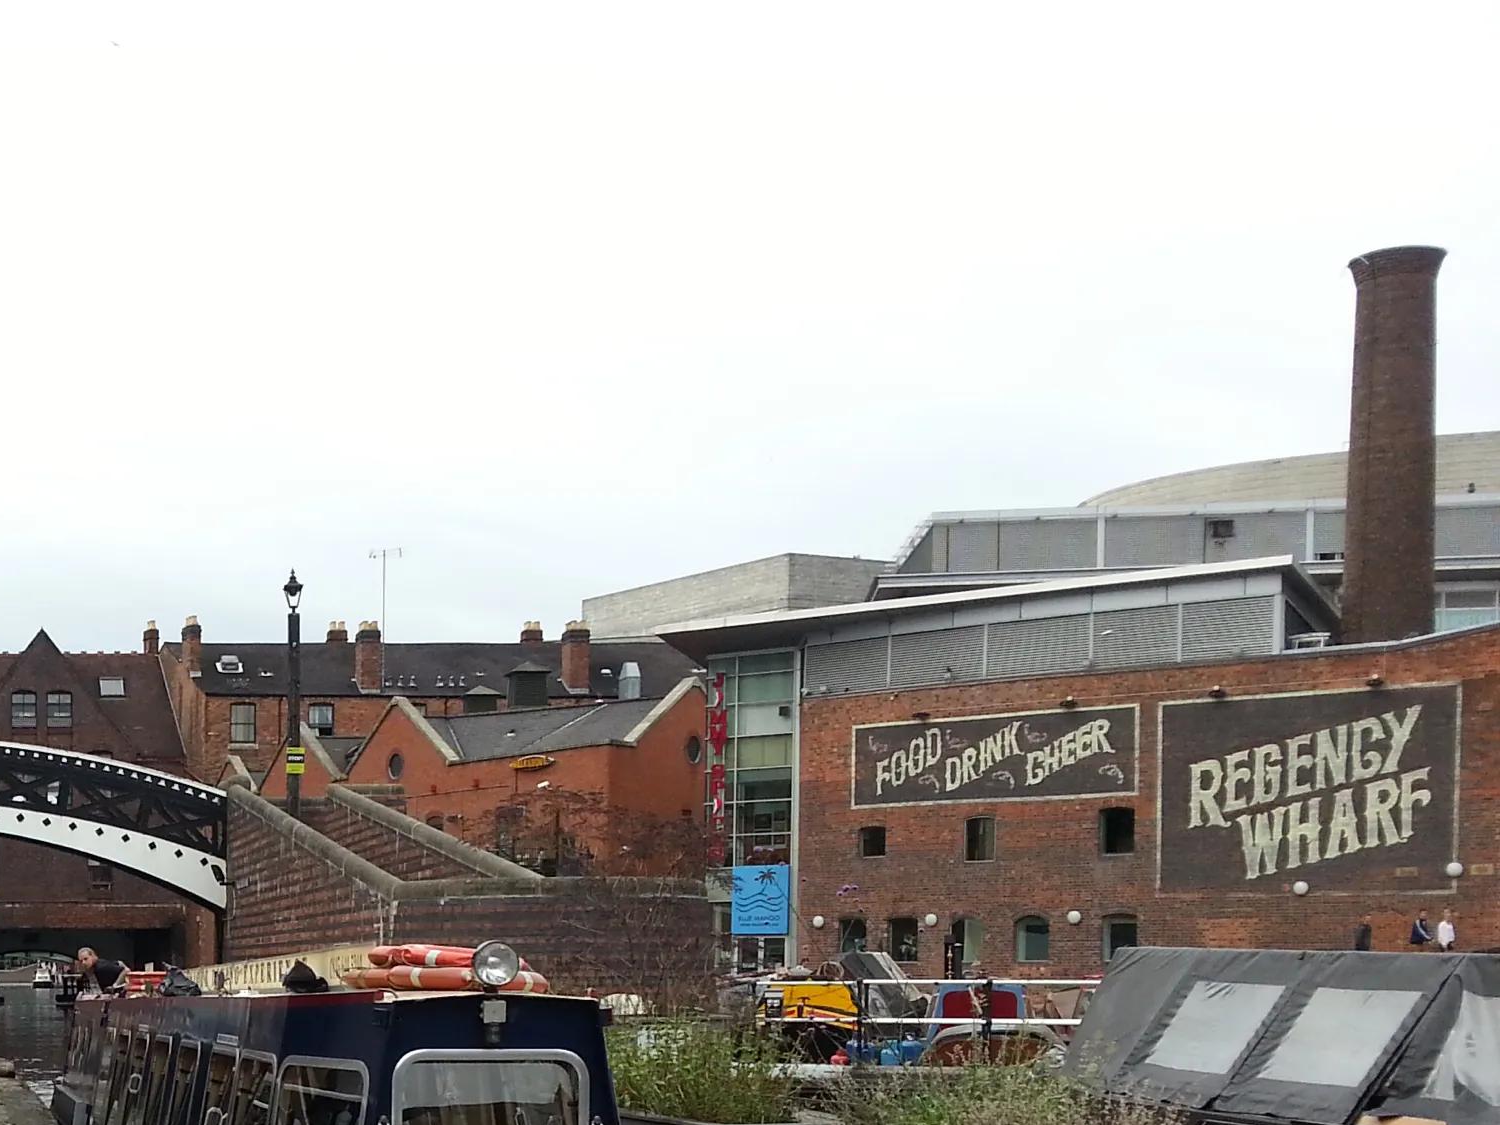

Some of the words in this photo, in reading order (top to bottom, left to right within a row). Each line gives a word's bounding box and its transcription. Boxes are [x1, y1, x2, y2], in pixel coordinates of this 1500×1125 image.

[875, 727, 942, 796] FOOD
[945, 721, 1025, 792] DRINK
[1024, 718, 1116, 786] CHEER
[1187, 704, 1424, 829] REGENCY
[1236, 767, 1432, 880] WHARF
[243, 957, 307, 984] EXPERIE
